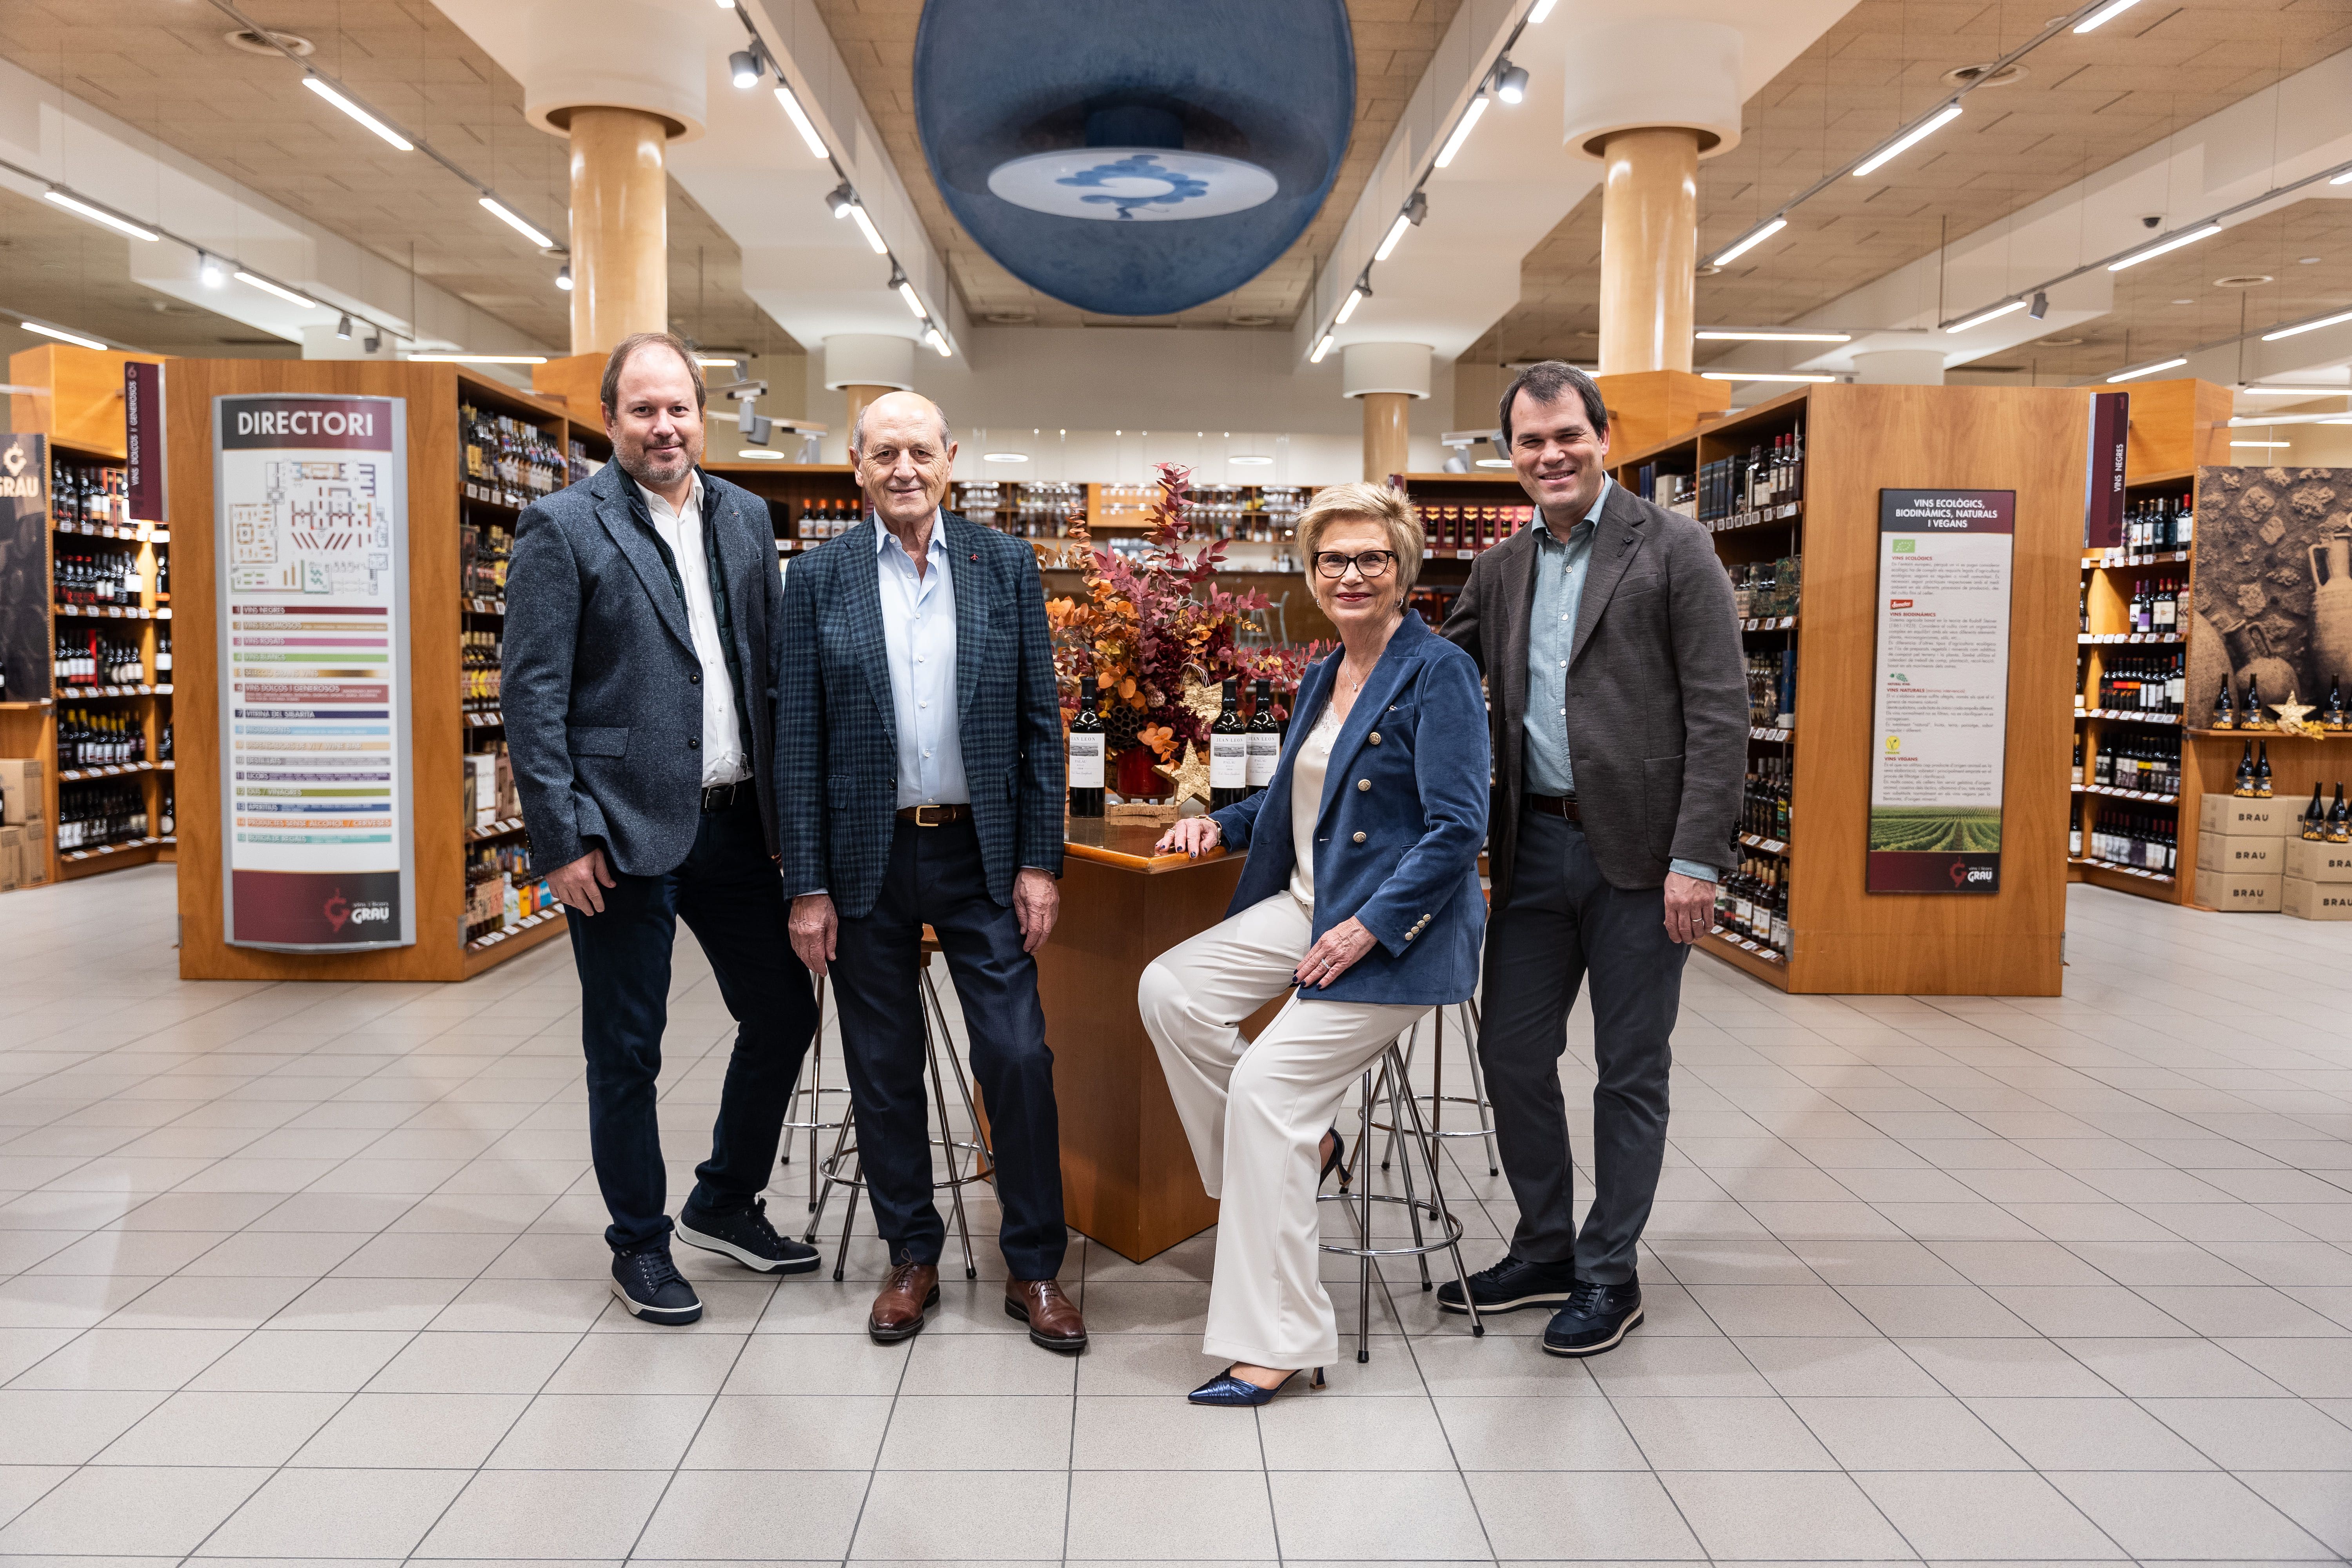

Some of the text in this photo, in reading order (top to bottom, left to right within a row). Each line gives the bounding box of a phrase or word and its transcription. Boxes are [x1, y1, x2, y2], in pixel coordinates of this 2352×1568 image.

[129, 380, 138, 426] GENEROSOS
[2120, 397, 2124, 410] 1
[237, 410, 374, 436] DIRECTORI
[2114, 443, 2124, 492] VINS NEGRES
[131, 467, 140, 486] VINS
[1913, 497, 1985, 509] VINS ECOLÒGICS,
[1896, 508, 1998, 519] BIODINÀMICS, NATURALS
[1927, 519, 1968, 528] I VEGANS
[2239, 813, 2269, 822] BRAU
[1967, 871, 1992, 883] GRAU
[2232, 889, 2264, 897] BRAU
[351, 907, 389, 924] GRAU
